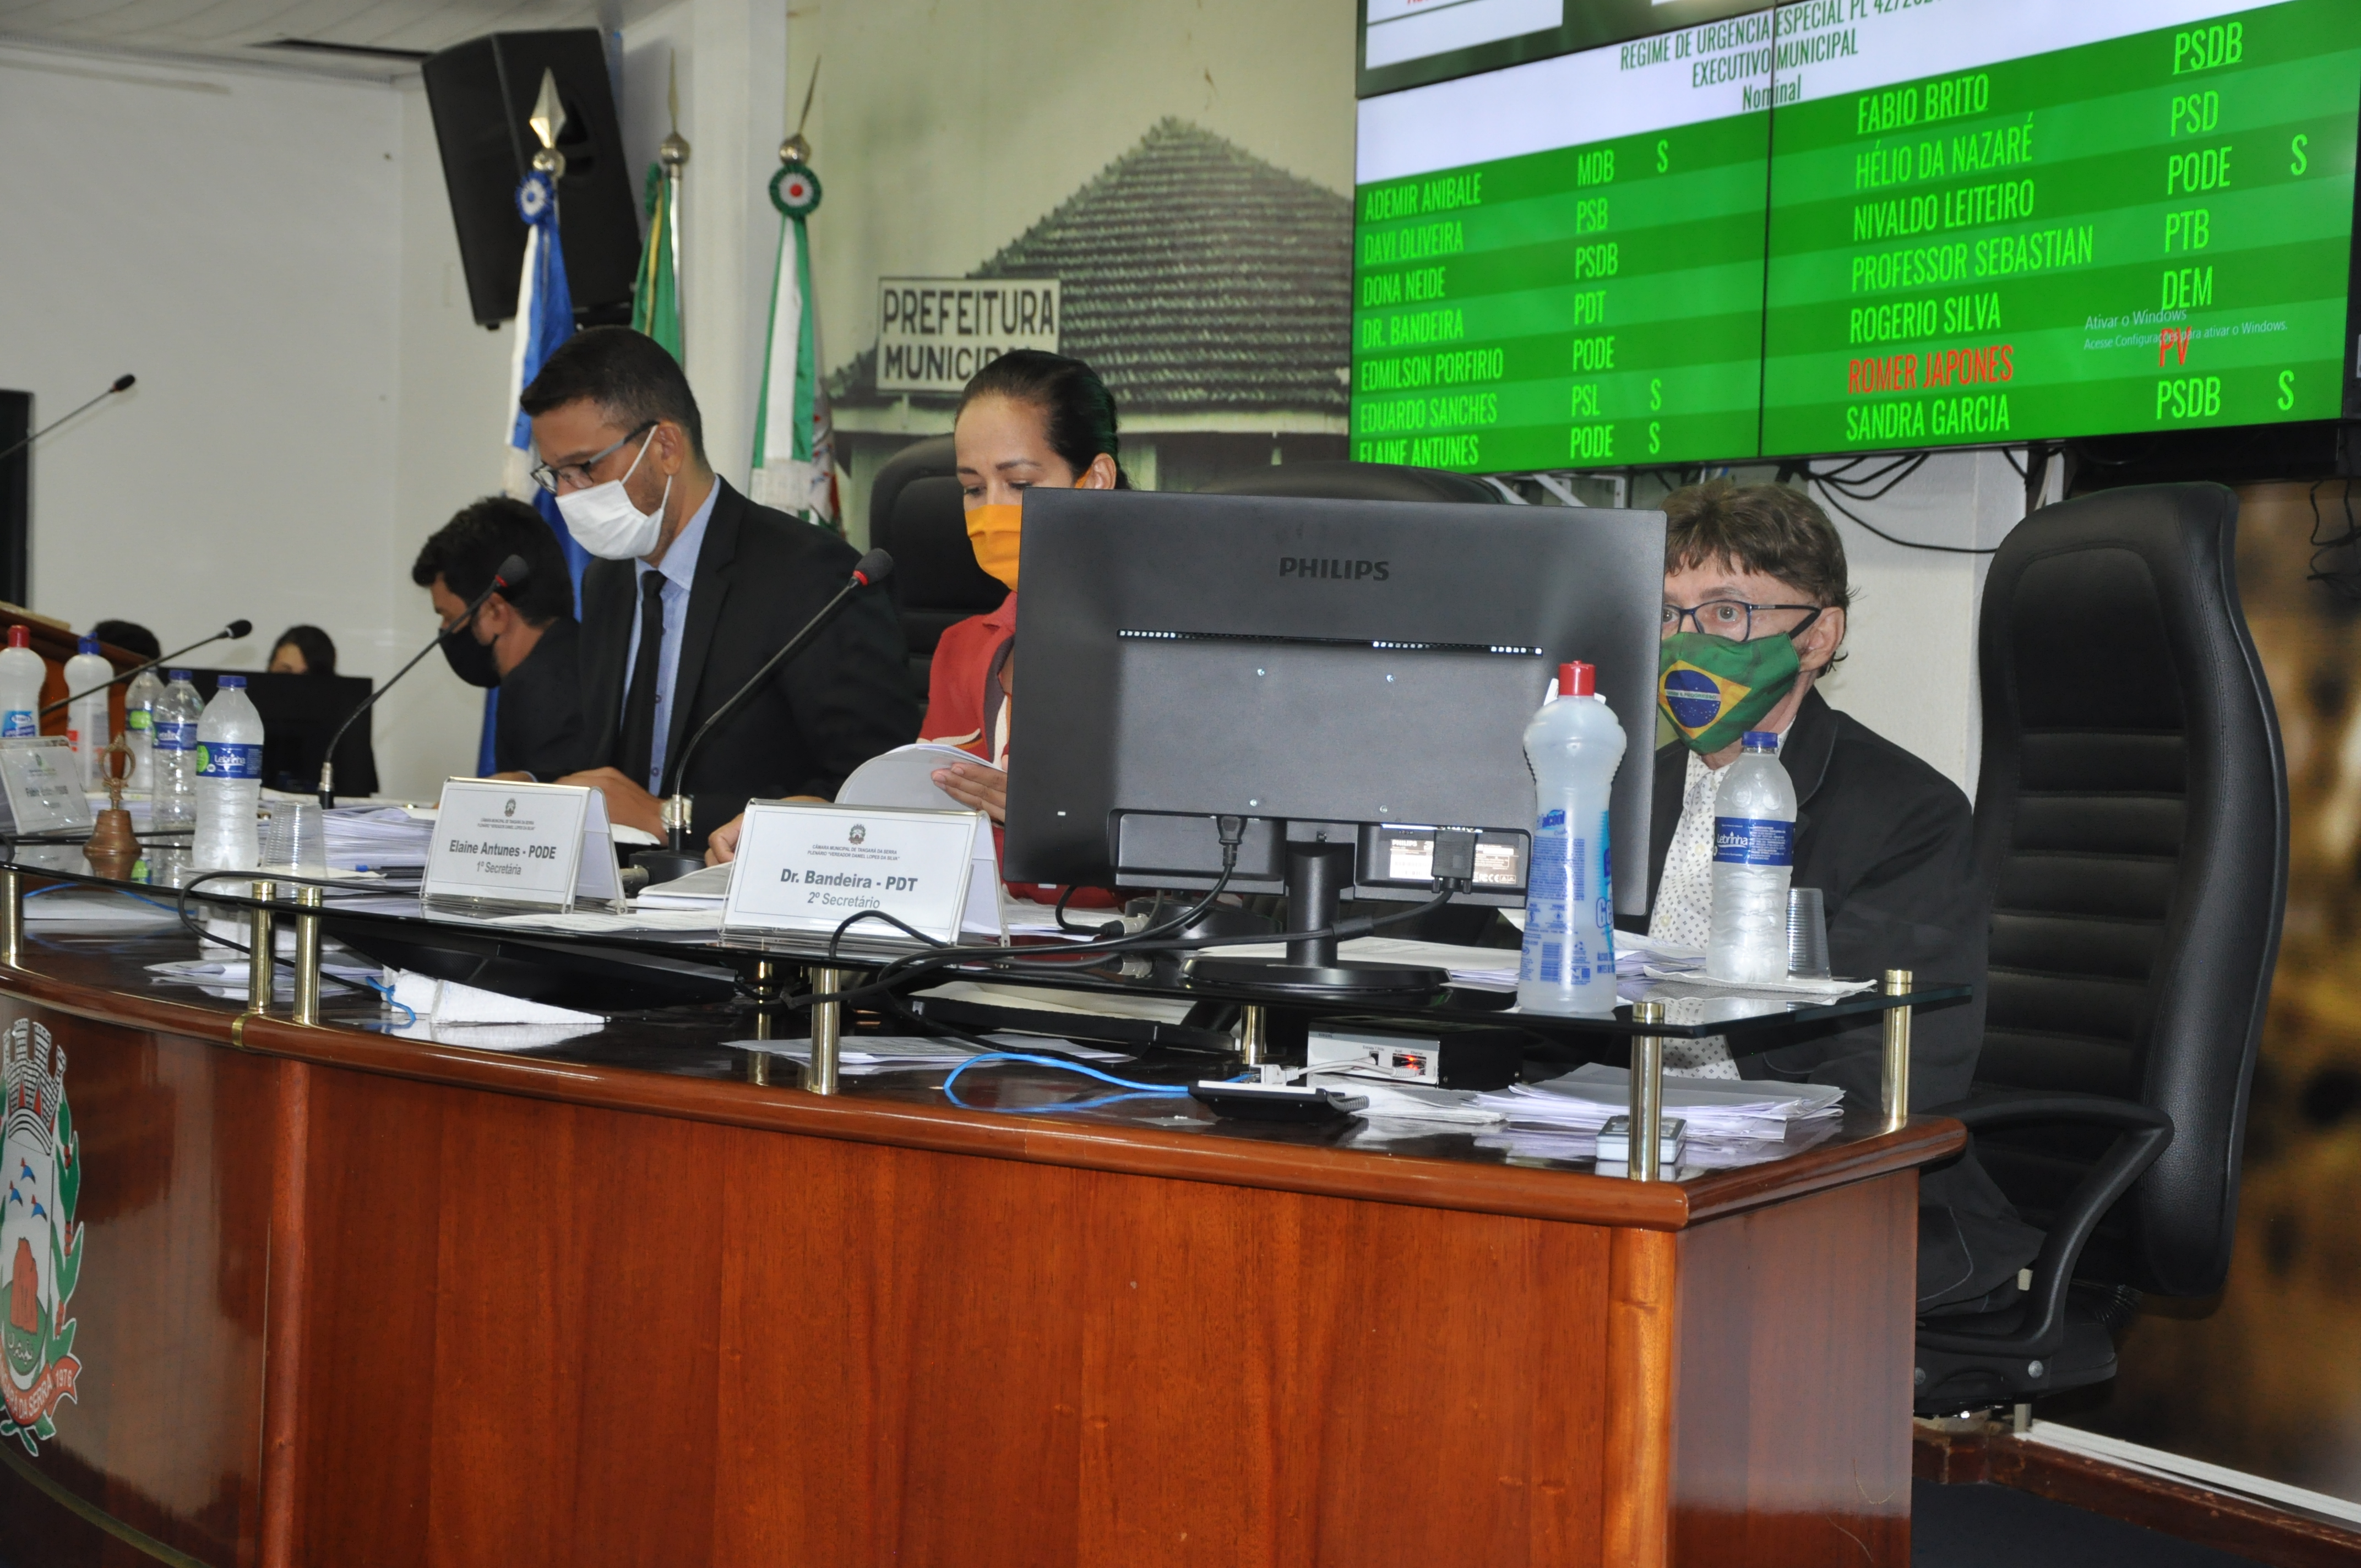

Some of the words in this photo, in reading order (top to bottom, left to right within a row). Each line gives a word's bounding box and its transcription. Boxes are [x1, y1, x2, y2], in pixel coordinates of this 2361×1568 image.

[1621, 35, 1670, 71] REGIME
[1675, 30, 1691, 60] DE
[1698, 15, 1770, 55] URGÊNCIA
[1775, 0, 1844, 37] ESPECIAL
[1851, 0, 1868, 20] PL
[2174, 21, 2243, 74] PSDB
[1693, 48, 1770, 89] EXECUTIVO
[1776, 28, 1858, 71] MUNICIPAL
[1742, 74, 1801, 112] Nominal
[1857, 87, 1917, 135] FABIO
[1927, 73, 1989, 121] BRITO
[2170, 90, 2219, 137] PSD
[1577, 149, 1614, 187] MDB
[1657, 140, 1668, 173] S
[1856, 140, 1912, 189] HÉLIO
[1919, 139, 1945, 179] DA
[1952, 111, 2034, 174] NAZARÉ
[2168, 146, 2232, 195] PODE
[2291, 133, 2308, 175] S
[1365, 184, 1418, 221] ADEMIR
[1422, 172, 1482, 208] ANIBALE
[1576, 197, 1608, 233] PSB
[1854, 193, 1938, 242] NIVALDO
[1945, 178, 2034, 228] LEITEIRO
[1364, 228, 1396, 265] DAVI
[1400, 221, 1464, 260] OLIVEIRA
[2166, 209, 2210, 253] PTB
[1575, 242, 1618, 280] PSDB
[1851, 242, 1968, 293] PROFESSOR
[1975, 225, 2093, 277] SEBASTIAN
[1363, 273, 1401, 307] DONA
[1405, 266, 1446, 301] NEIDE
[2162, 265, 2212, 311] DEM
[883, 289, 1054, 335] PREFEITURA
[1362, 318, 1386, 349] DR.
[1390, 308, 1464, 346] BANDEIRA
[1574, 291, 1606, 325] PDT
[1850, 299, 1936, 344] ROGERIO
[1944, 292, 2001, 334] SILVA
[2085, 314, 2118, 330] Ativar
[2121, 315, 2129, 326] o
[2132, 309, 2186, 325] Windows
[1573, 336, 1615, 372] PODE
[2084, 338, 2113, 351] Acesse
[2115, 331, 2178, 348] Configurações
[2180, 329, 2201, 342] para
[2204, 325, 2229, 339] ativar
[2233, 326, 2238, 335] o
[2241, 320, 2288, 334] Windows.
[2159, 326, 2191, 367] PV
[1361, 356, 1432, 391] EDMILSON
[1435, 348, 1503, 384] PORFIRIO
[1848, 353, 1917, 395] ROMER
[1923, 345, 2014, 388] JAPONES
[2278, 369, 2294, 410] S
[1360, 400, 1425, 433] EDUARDO
[1430, 393, 1497, 427] SANCHES
[1571, 385, 1600, 417] PSL
[1651, 379, 1662, 411] S
[2157, 376, 2221, 420] PSDB
[1649, 422, 1660, 455] S
[1847, 400, 1925, 442] SANDRA
[1932, 394, 2010, 436] GARCIA
[1411, 434, 1478, 467] ANTUNES
[1570, 426, 1614, 459] PODE
[1279, 557, 1389, 581] PHILIPS
[449, 839, 478, 854] Elaine
[481, 842, 520, 857] Antunes
[528, 845, 557, 859] PODE
[1717, 833, 1748, 846] Lebrinha
[485, 862, 521, 875] Secretária
[780, 868, 799, 884] Dr.
[804, 870, 872, 889] Bandeira
[885, 876, 918, 892] PDT
[822, 892, 880, 909] Secretário
[29, 1373, 53, 1417] SERRA
[55, 1369, 73, 1388] 1976
